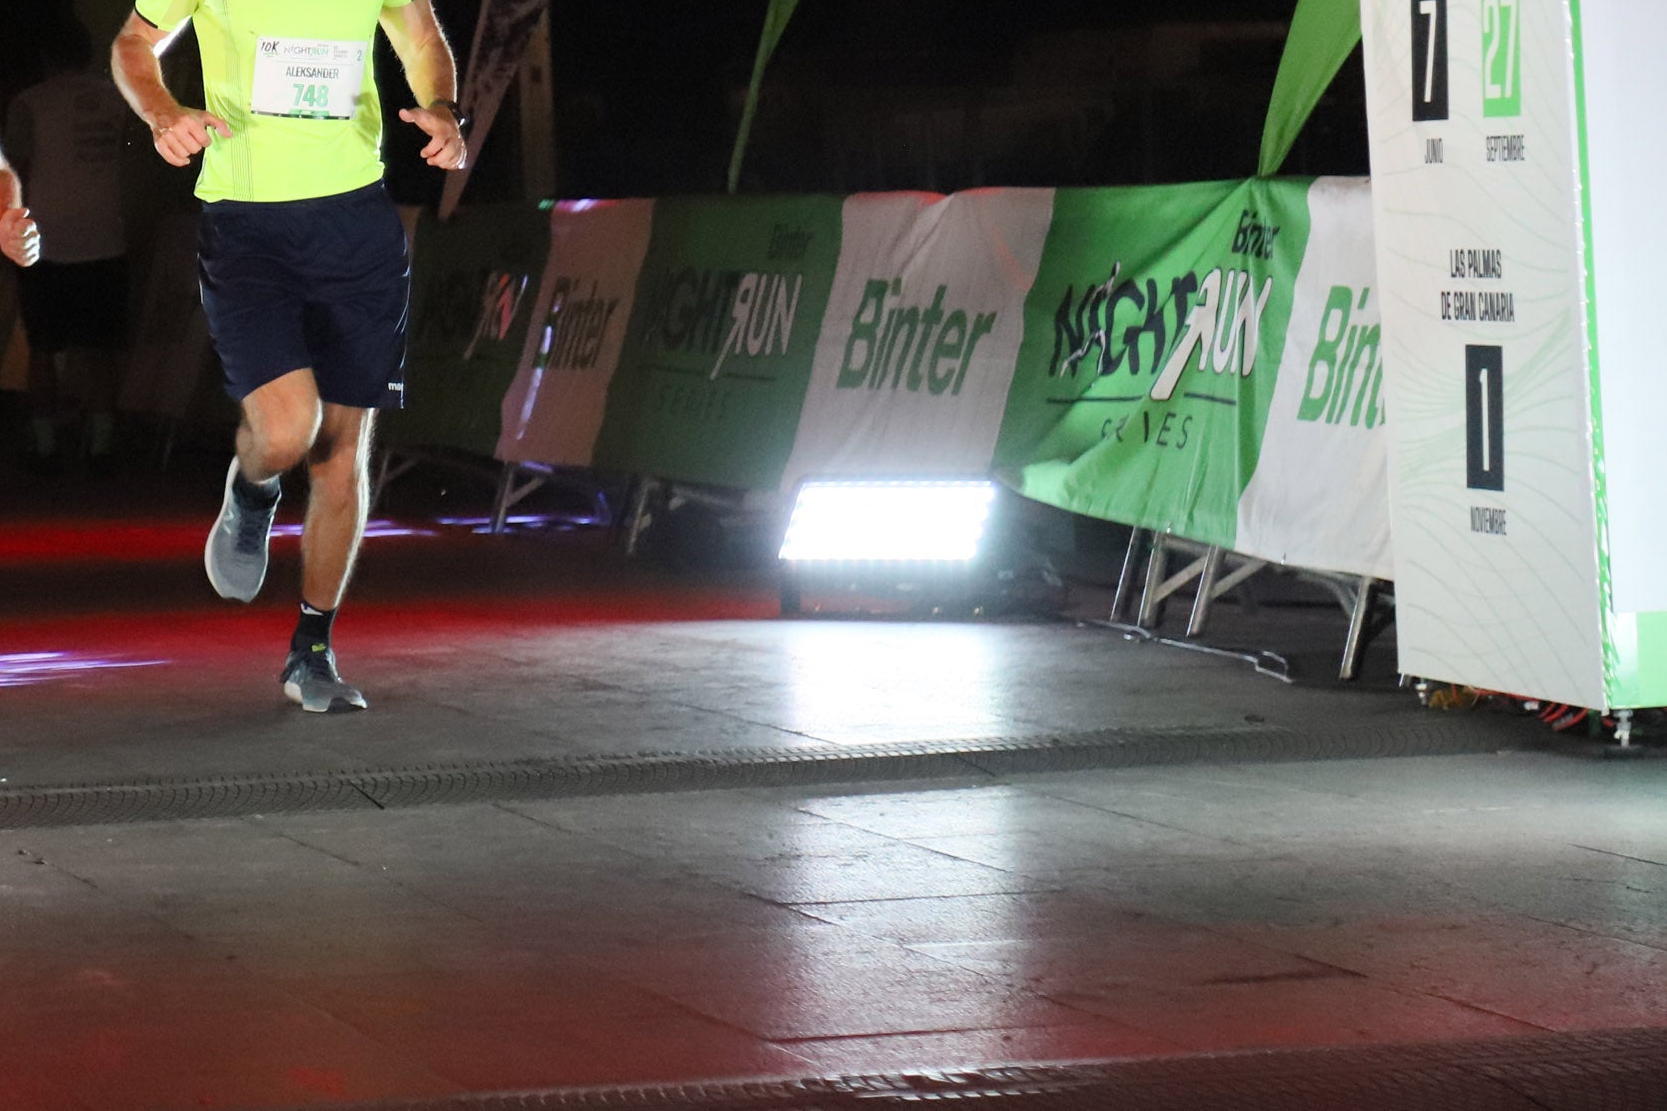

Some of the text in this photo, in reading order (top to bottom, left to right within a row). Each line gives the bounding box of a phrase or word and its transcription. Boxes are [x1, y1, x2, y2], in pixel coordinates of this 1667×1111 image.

[1419, 0, 1437, 103] 7
[285, 66, 340, 79] ALEKSANDER
[292, 83, 330, 108] 748
[1486, 135, 1525, 162] SEPTIEMBRE
[1232, 209, 1280, 260] Binter
[1449, 250, 1502, 278] LAS PALMAS
[1441, 291, 1515, 322] DE GRAN CANARIA
[836, 277, 998, 397] Binter
[1479, 368, 1490, 472] 1
[1470, 505, 1507, 536] NOVIEMBRE
